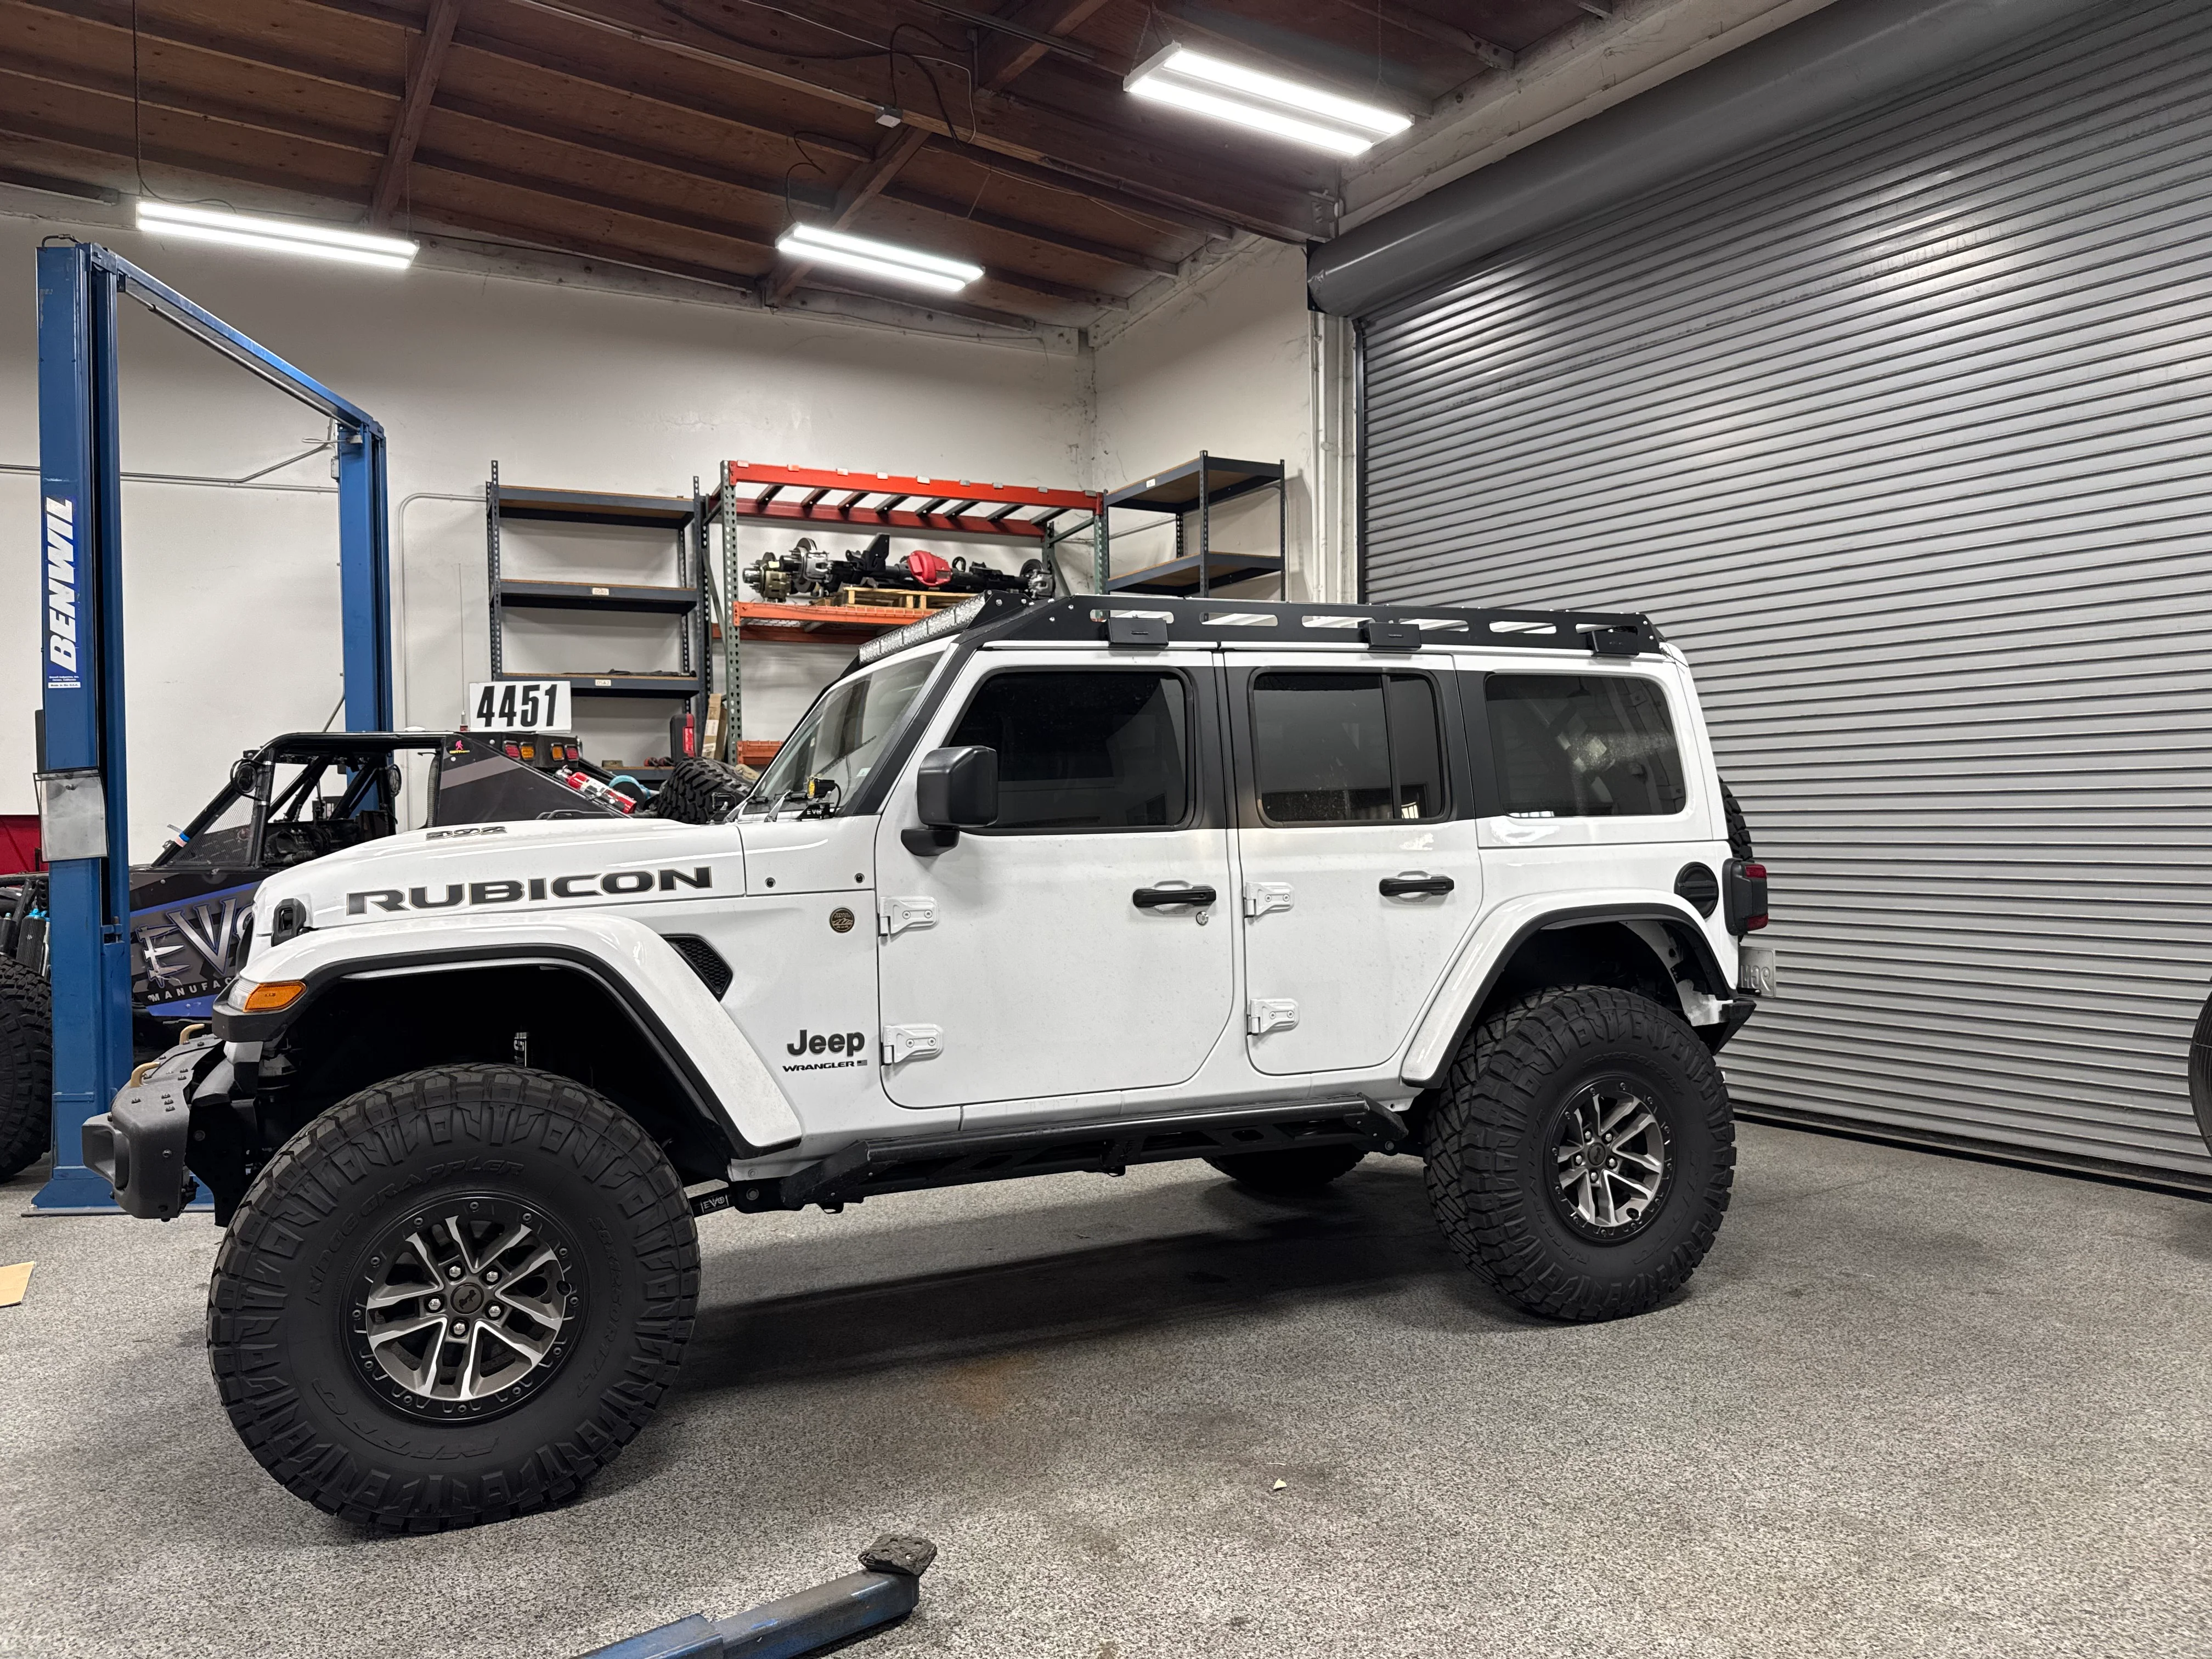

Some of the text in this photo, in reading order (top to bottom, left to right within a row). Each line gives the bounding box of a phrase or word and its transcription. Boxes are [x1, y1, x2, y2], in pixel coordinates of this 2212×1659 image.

[46, 496, 77, 673] BENWIL
[476, 684, 558, 727] 4451
[346, 866, 713, 916] RUBICON
[787, 1029, 865, 1057] Jeep
[782, 1060, 855, 1073] WRANGLER
